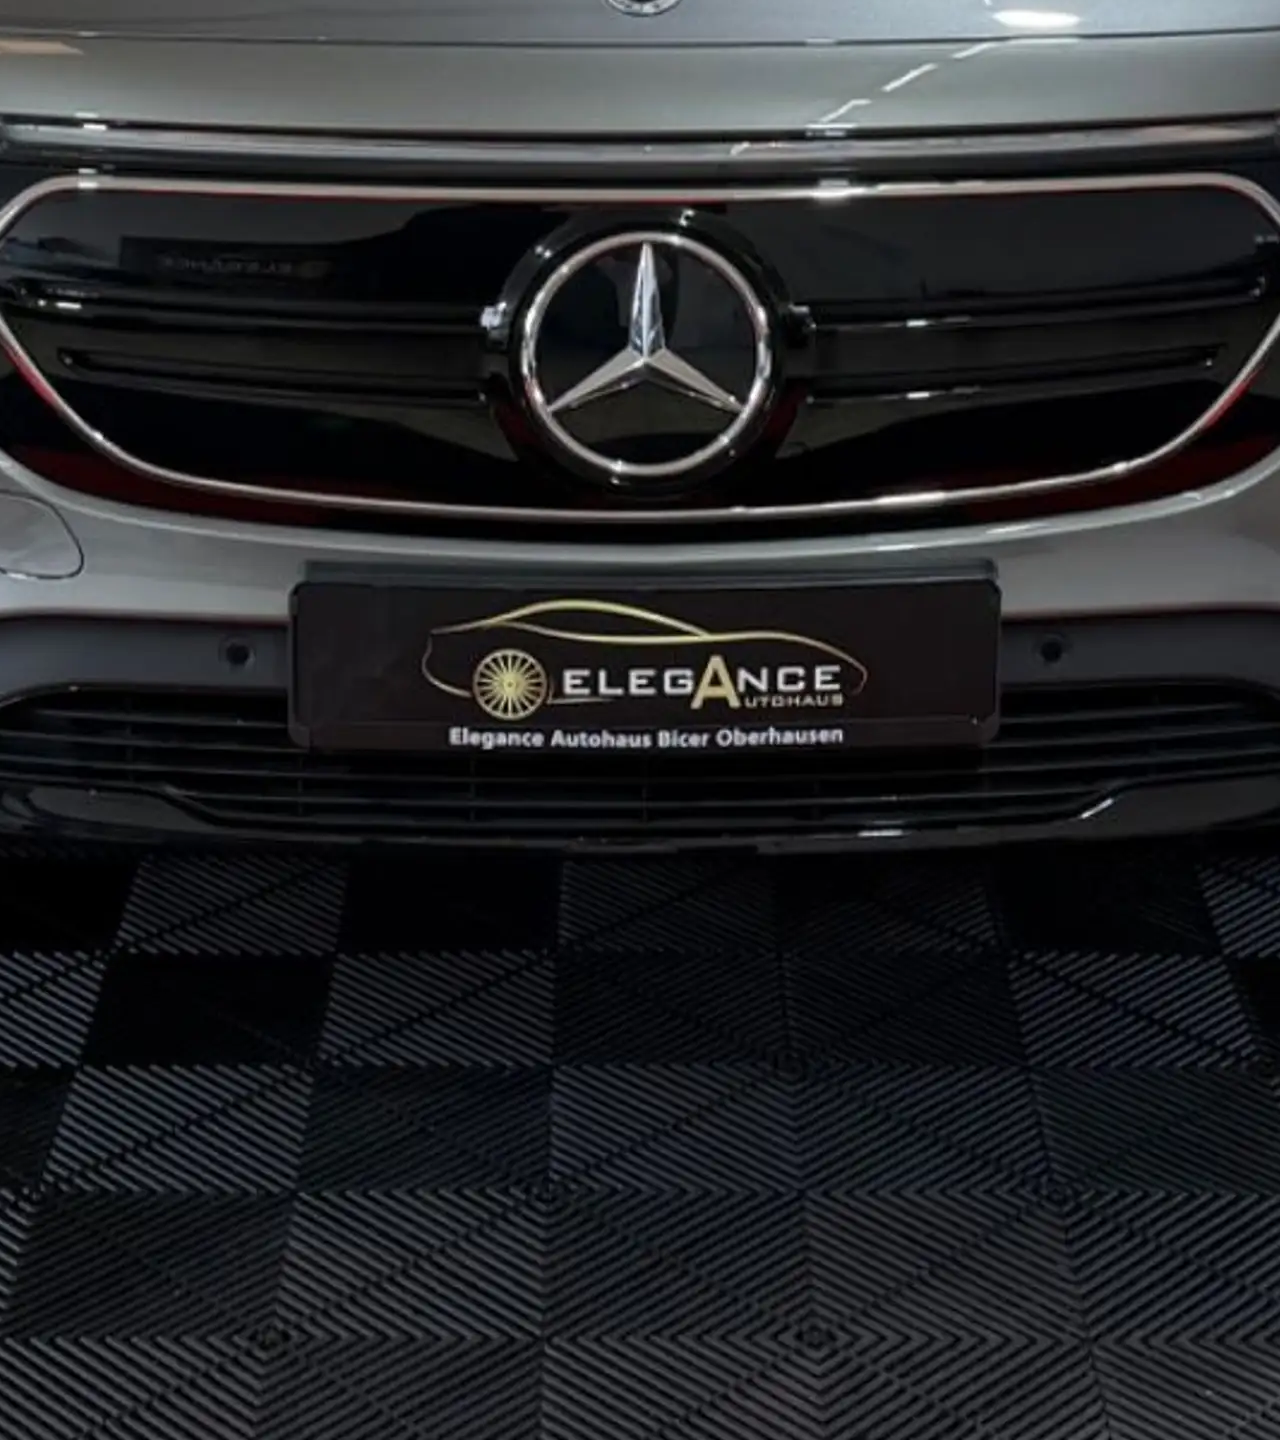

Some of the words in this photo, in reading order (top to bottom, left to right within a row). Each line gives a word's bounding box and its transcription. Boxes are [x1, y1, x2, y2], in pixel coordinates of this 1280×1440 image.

[562, 654, 841, 710] ELEGANCE
[448, 726, 545, 749] Elegance
[551, 729, 651, 748] Autohaus
[657, 729, 710, 748] Bicer
[716, 727, 844, 747] Oberhausen
